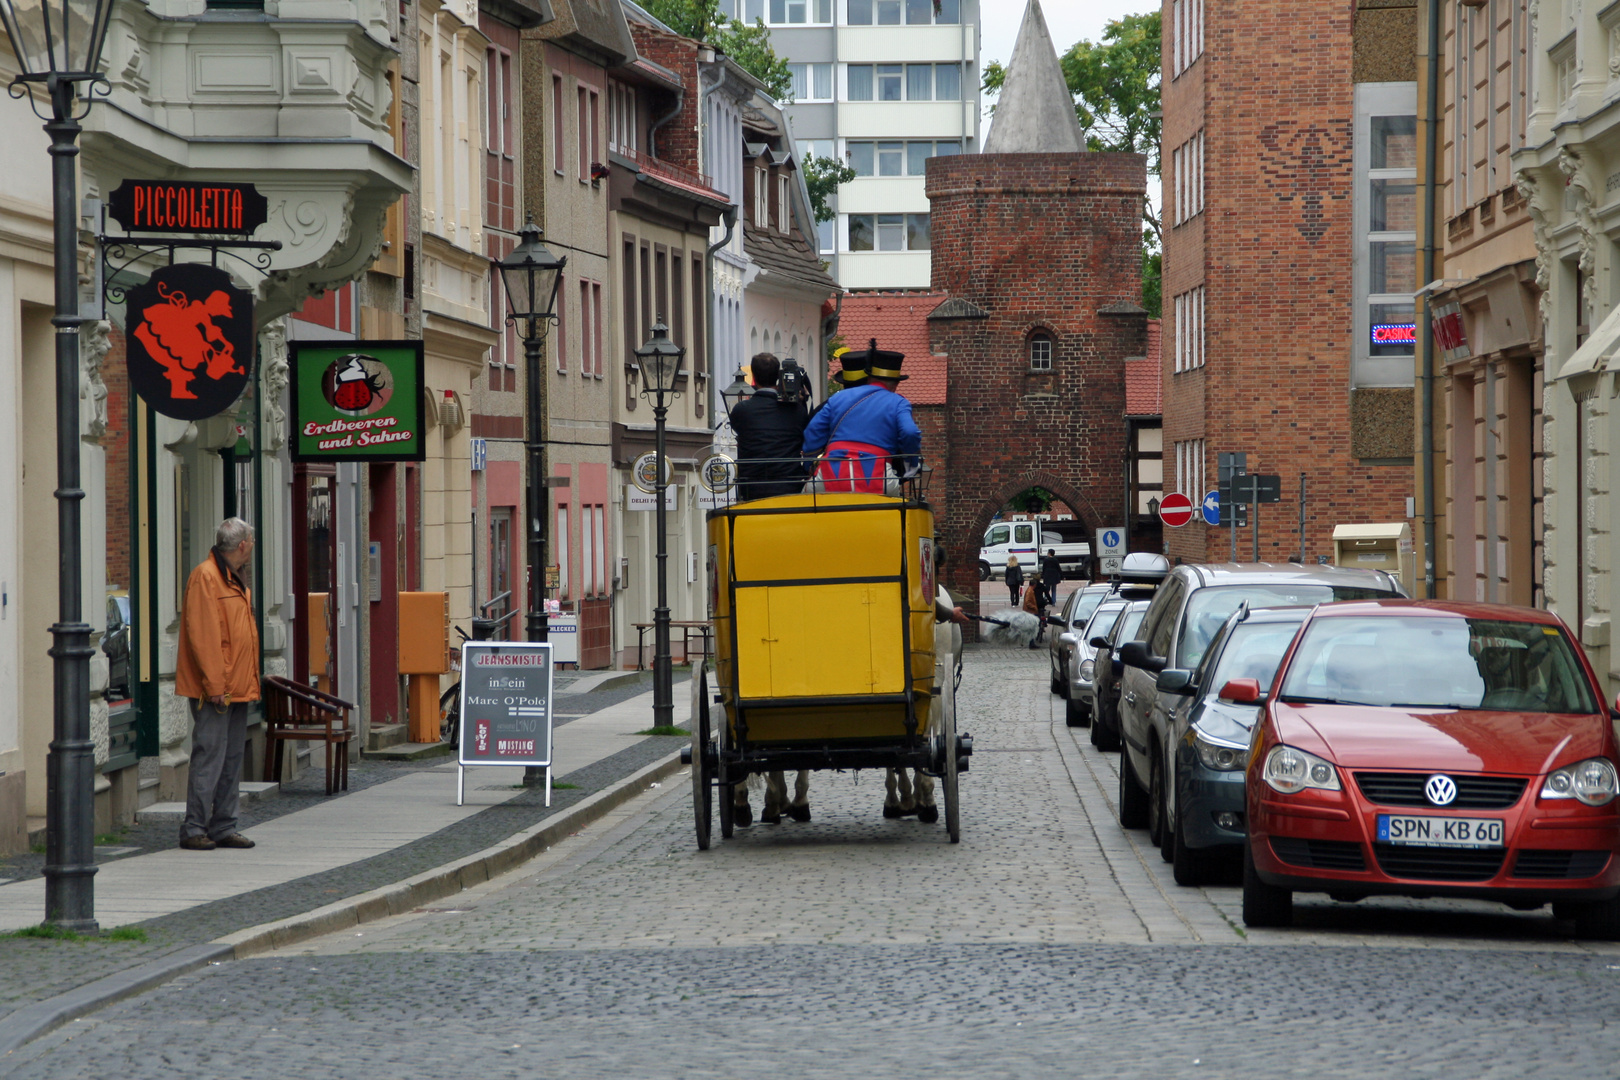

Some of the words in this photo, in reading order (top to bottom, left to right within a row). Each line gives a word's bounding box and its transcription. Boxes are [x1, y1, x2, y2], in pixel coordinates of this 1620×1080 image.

[134, 185, 243, 229] PICCOLETTA
[303, 416, 398, 436] Erdbeeren
[319, 434, 354, 450] und
[356, 430, 412, 446] Sahne
[477, 654, 543, 666] JEANSKISTE
[468, 696, 499, 705] Marc
[504, 696, 546, 706] O'Polo
[1391, 819, 1430, 838] SPN
[1444, 821, 1470, 839] KB
[1475, 823, 1500, 841] 60
